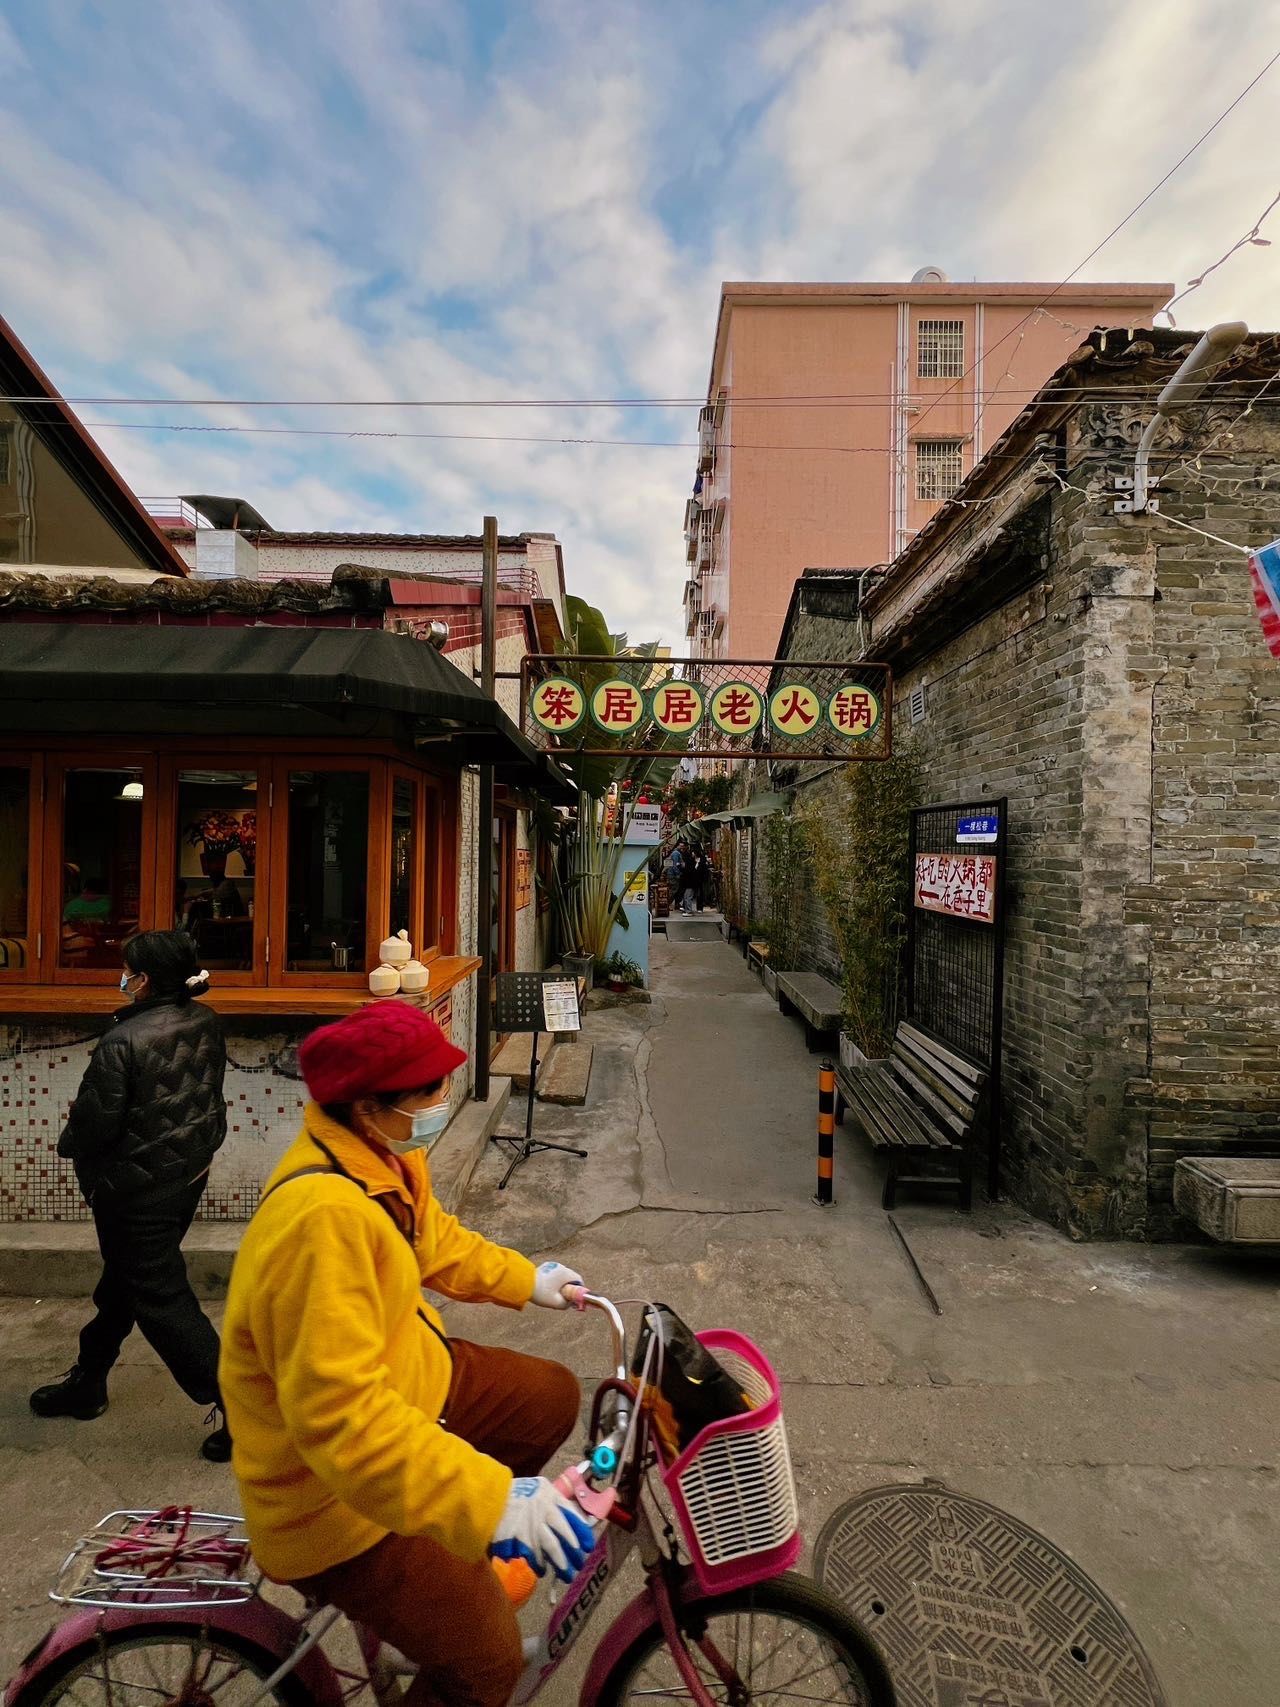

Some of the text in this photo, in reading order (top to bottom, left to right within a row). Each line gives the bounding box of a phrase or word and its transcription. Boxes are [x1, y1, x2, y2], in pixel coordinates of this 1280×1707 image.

[539, 686, 872, 729] 笨居居老火锅
[915, 856, 993, 891] 好吃的火锅都
[940, 884, 989, 919] 在巷子里
[943, 1559, 977, 1578] 污水
